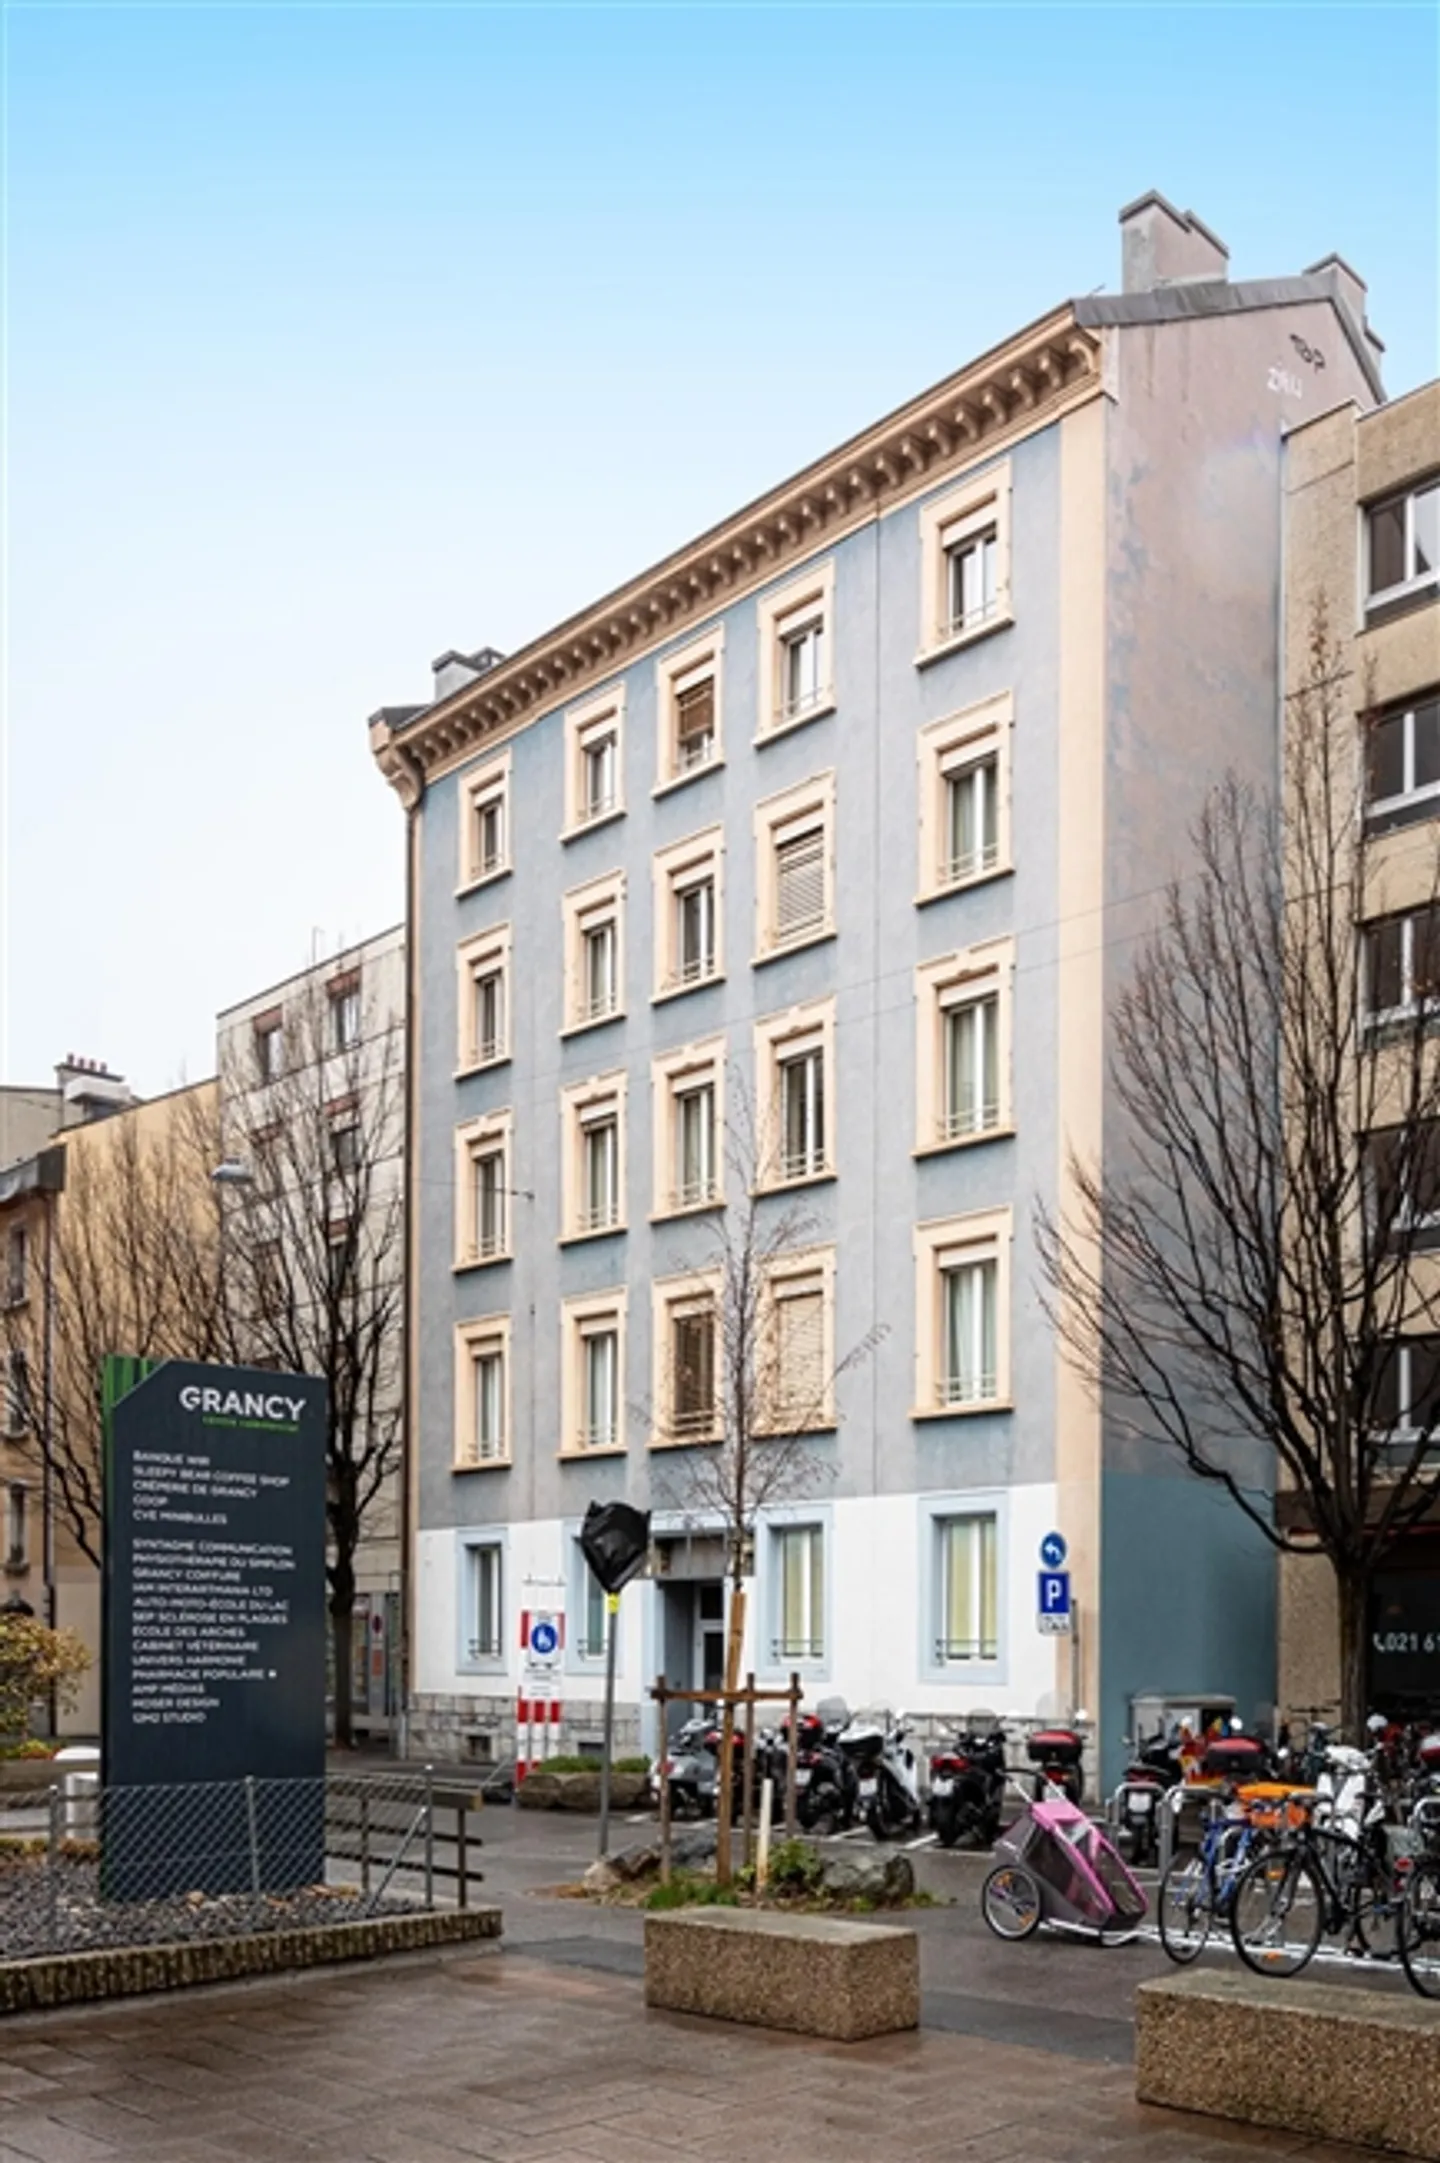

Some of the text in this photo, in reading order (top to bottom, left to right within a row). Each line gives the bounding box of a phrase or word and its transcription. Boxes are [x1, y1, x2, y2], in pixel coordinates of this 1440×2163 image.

[179, 1386, 306, 1421] GRANCY
[133, 1450, 183, 1465] BANQUE
[133, 1465, 290, 1487] SLEEPY BEAR COFFEE SHOP
[193, 1484, 207, 1495] DE
[211, 1486, 258, 1499] GRANCY
[133, 1494, 169, 1507] COOP
[133, 1509, 227, 1524] CVE MINIBULLES
[199, 1541, 293, 1556] COMMUNICATION
[229, 1557, 246, 1568] DU
[249, 1559, 296, 1570] SIMPLON
[133, 1567, 241, 1581] GRANCY COIFFURE
[252, 1585, 273, 1597] LTD
[1046, 1579, 1061, 1609] P
[249, 1600, 265, 1611] DU
[219, 1613, 235, 1623] EN
[238, 1614, 288, 1624] PLAQUES
[173, 1626, 197, 1637] DES
[200, 1626, 245, 1637] ARCHES
[132, 1640, 183, 1652] CABINET
[1386, 1632, 1418, 1652] 021
[132, 1656, 183, 1666] UNIVERS
[132, 1669, 264, 1680] PHARMACIE POPULAIRE
[176, 1698, 220, 1710] DESIGN
[163, 1712, 206, 1723] STUDIO
